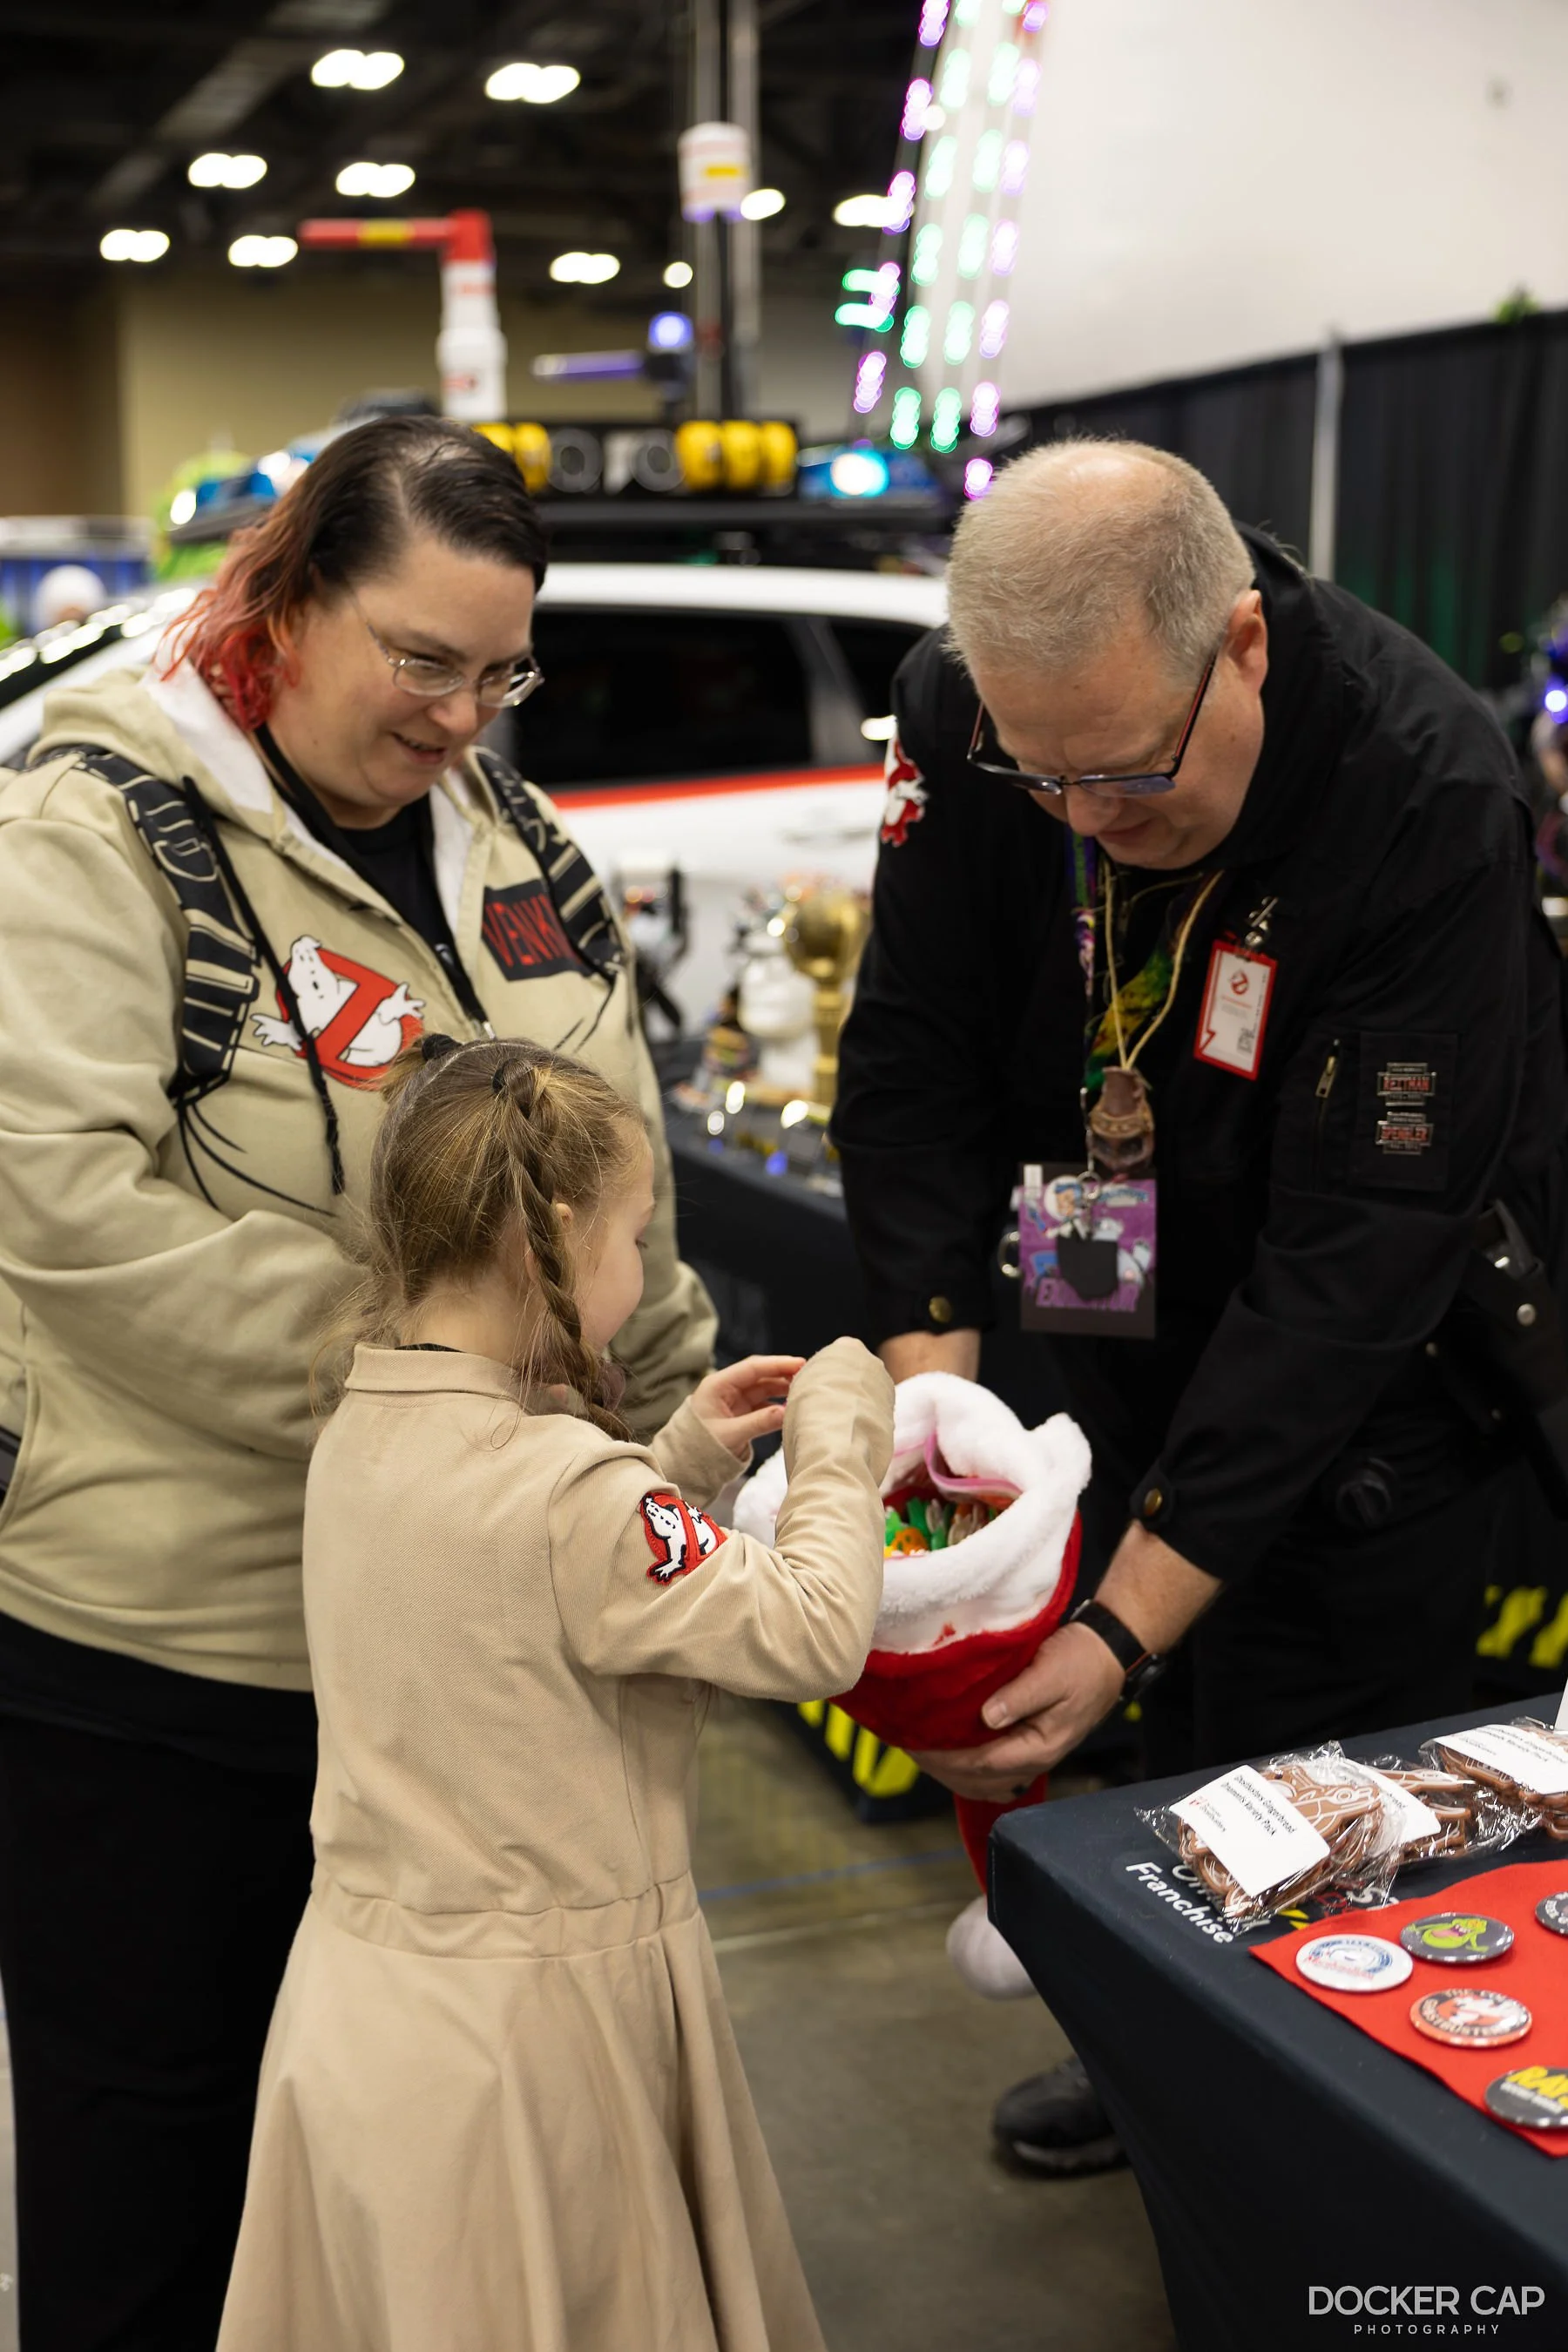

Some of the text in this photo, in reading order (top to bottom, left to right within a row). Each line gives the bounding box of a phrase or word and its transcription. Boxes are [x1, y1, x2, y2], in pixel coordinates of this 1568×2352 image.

[1245, 1801, 1263, 1822] Variety
[1263, 1819, 1277, 1838] Pack
[1263, 1800, 1297, 1835] Gingerbread
[1125, 1862, 1233, 1943] Franchise
